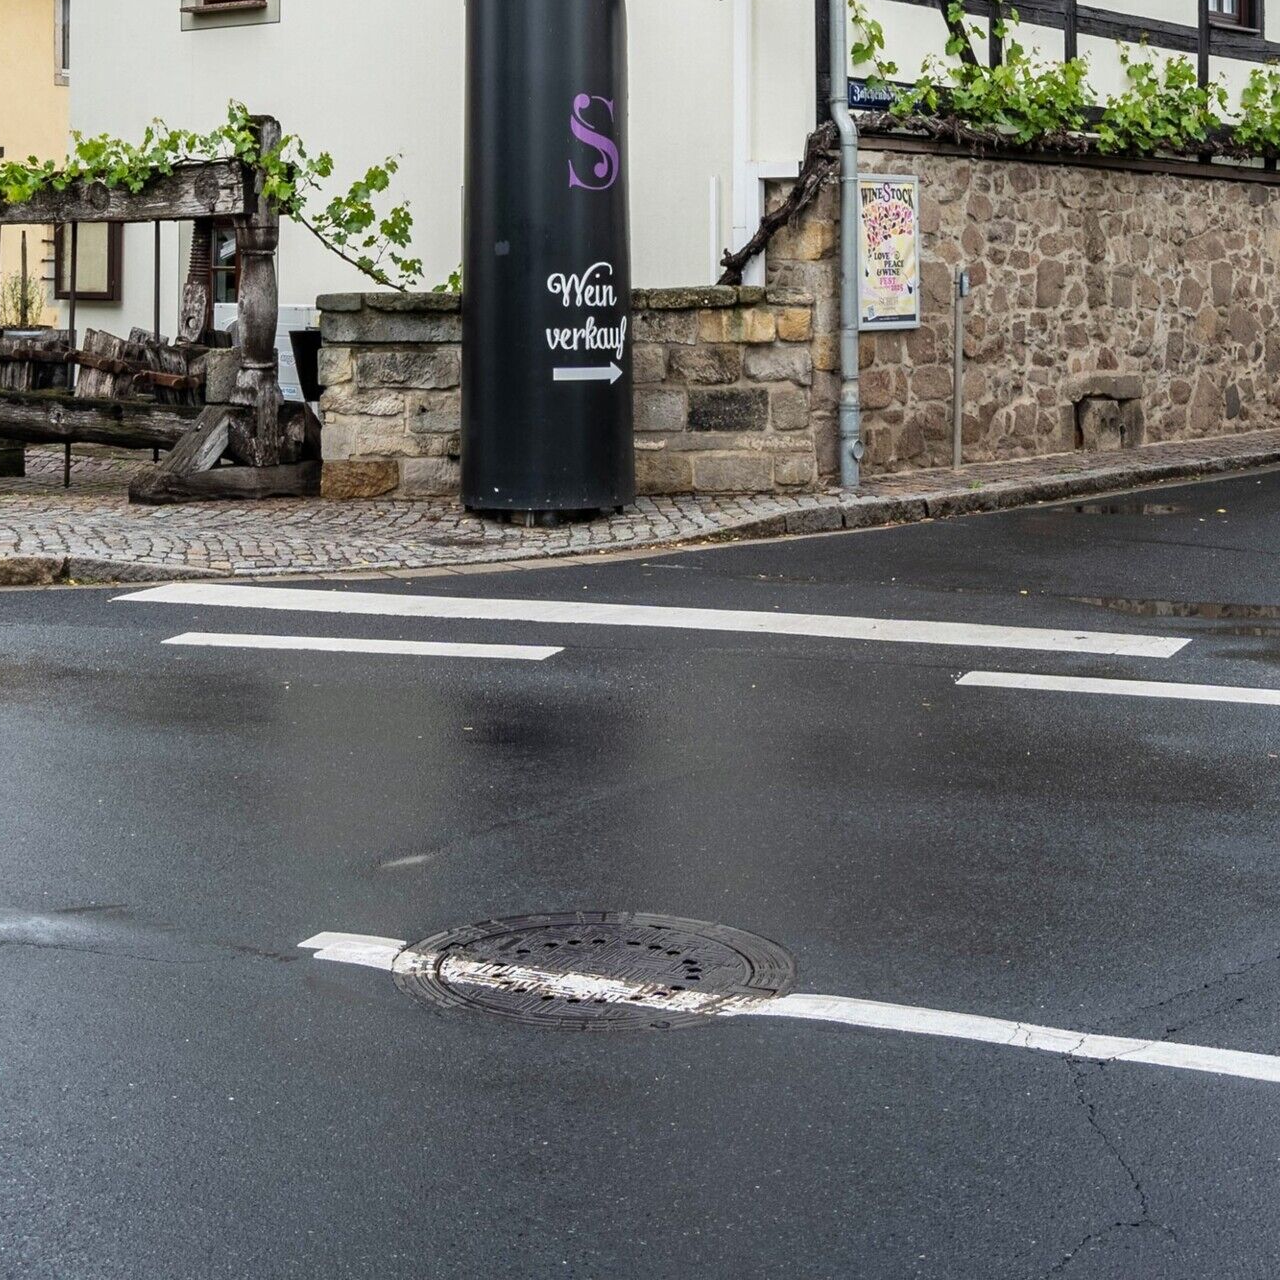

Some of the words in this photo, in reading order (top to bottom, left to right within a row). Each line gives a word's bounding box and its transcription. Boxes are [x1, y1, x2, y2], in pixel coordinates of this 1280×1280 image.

[568, 93, 620, 191] S
[861, 182, 914, 210] WINESTOCK
[874, 252, 889, 260] LOVE
[884, 260, 905, 268] PEACE
[879, 277, 896, 285] FEST
[883, 268, 901, 276] WINE
[547, 261, 617, 308] Wein
[545, 315, 628, 360] verkauf
